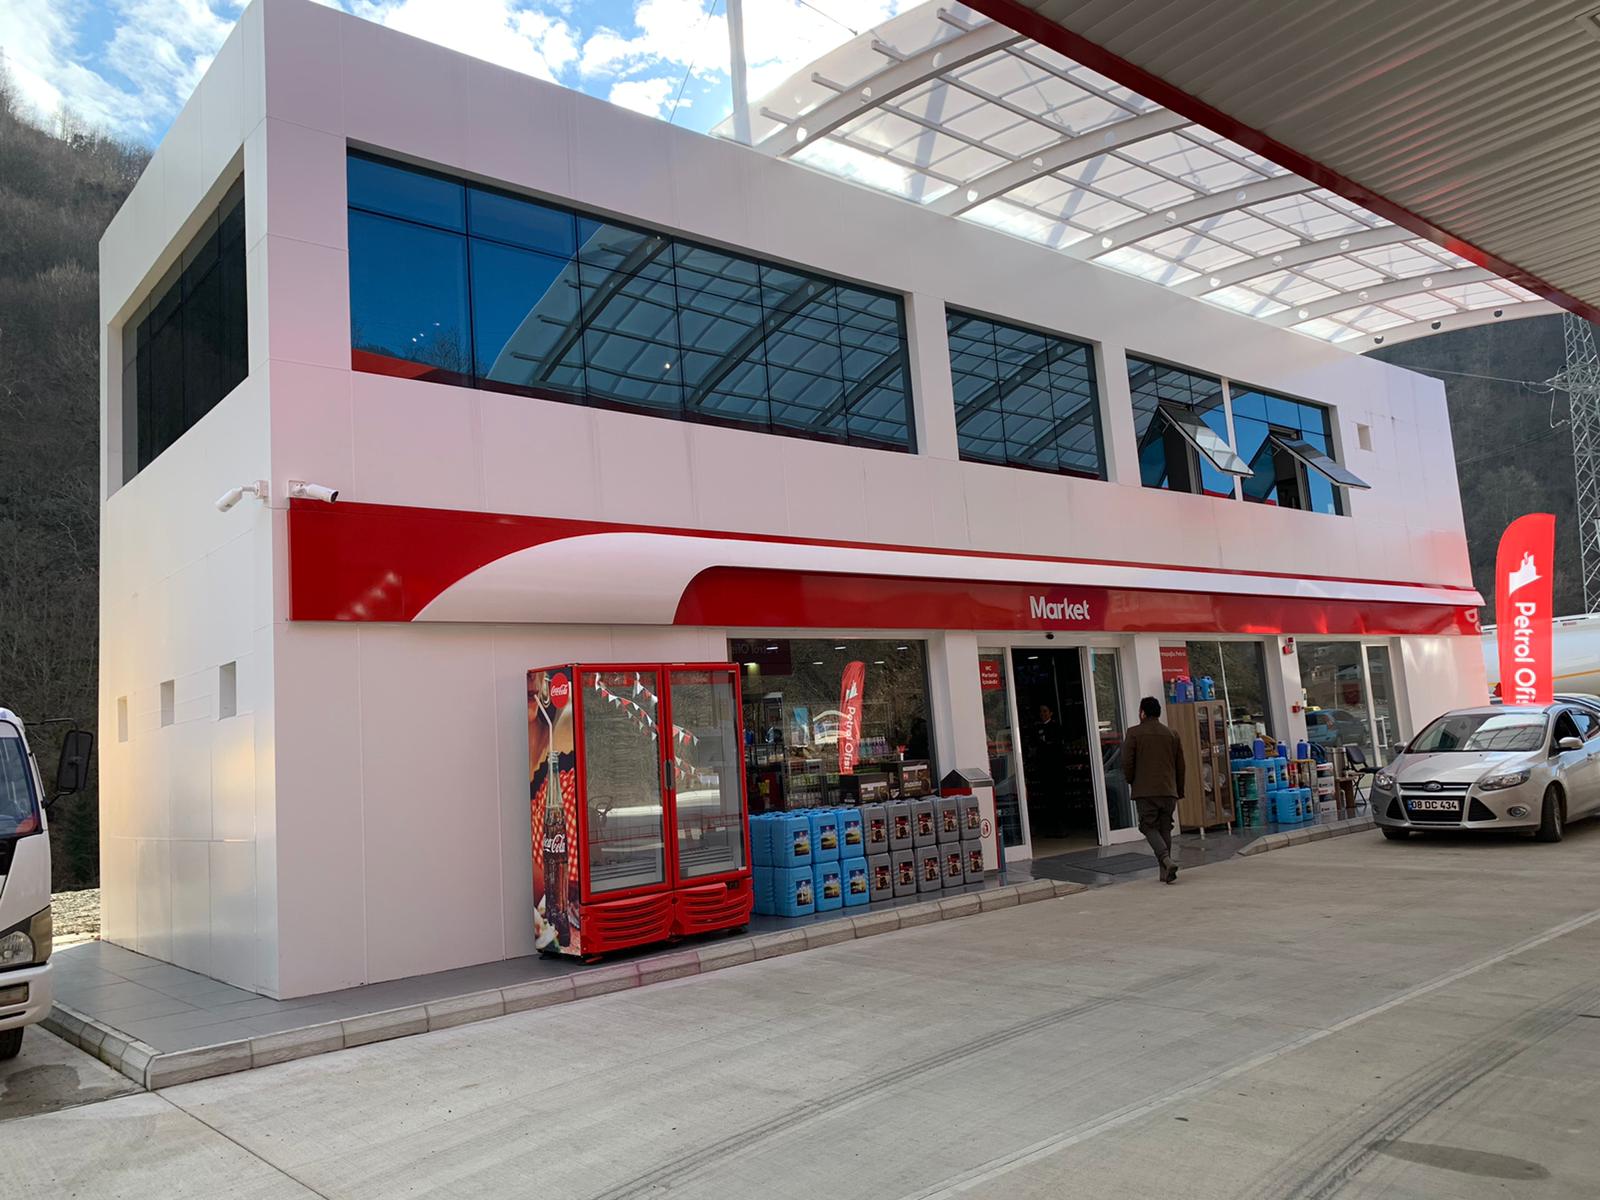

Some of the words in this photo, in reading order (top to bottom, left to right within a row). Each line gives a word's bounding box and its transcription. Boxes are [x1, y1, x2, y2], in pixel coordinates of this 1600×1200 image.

[1029, 595, 1090, 620] Market
[1514, 602, 1536, 662] Petrol
[1514, 668, 1536, 704] Ofi
[1412, 801, 1422, 809] 08
[1425, 801, 1437, 809] DC
[1440, 801, 1457, 810] 434
